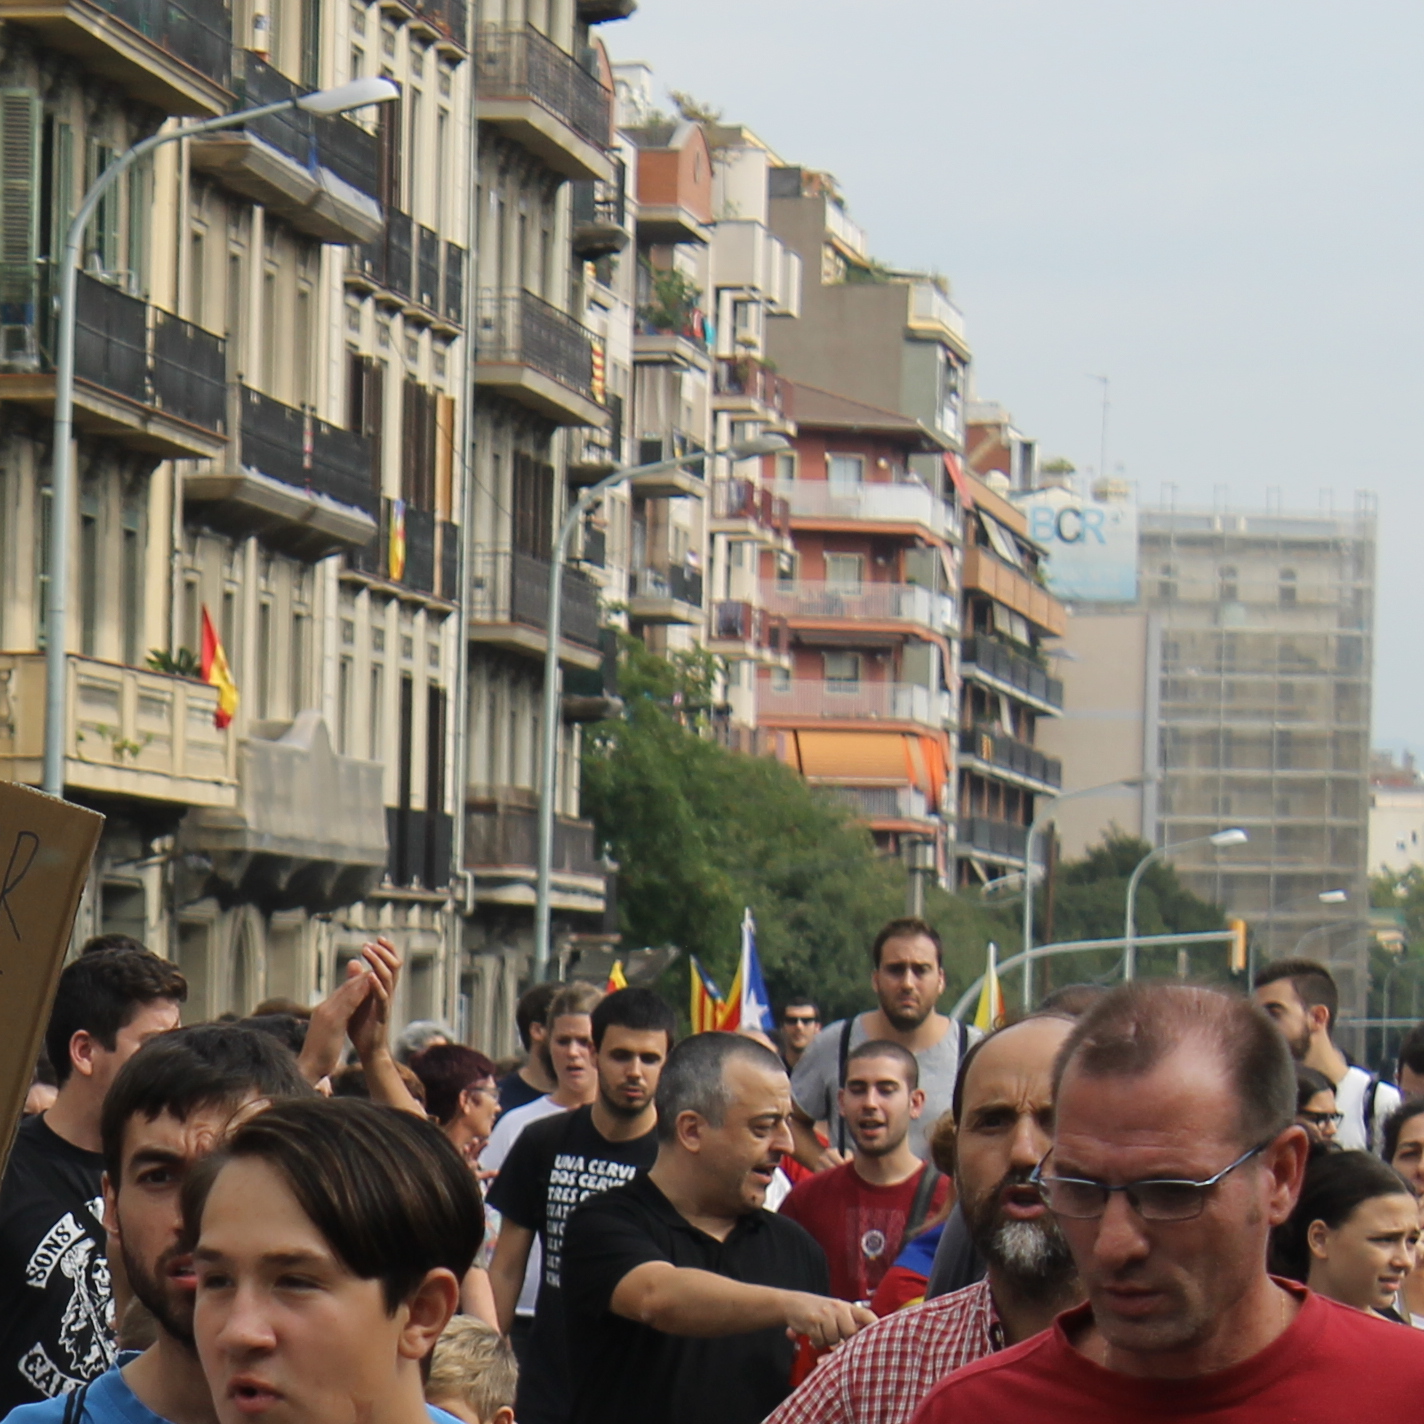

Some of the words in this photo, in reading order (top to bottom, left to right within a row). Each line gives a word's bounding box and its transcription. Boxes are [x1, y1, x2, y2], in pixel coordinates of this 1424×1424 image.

[1031, 505, 1106, 545] BCR
[554, 1154, 585, 1172] UNA
[549, 1169, 578, 1186] DOS
[547, 1186, 578, 1203] TRES
[32, 1222, 71, 1283] SONS
